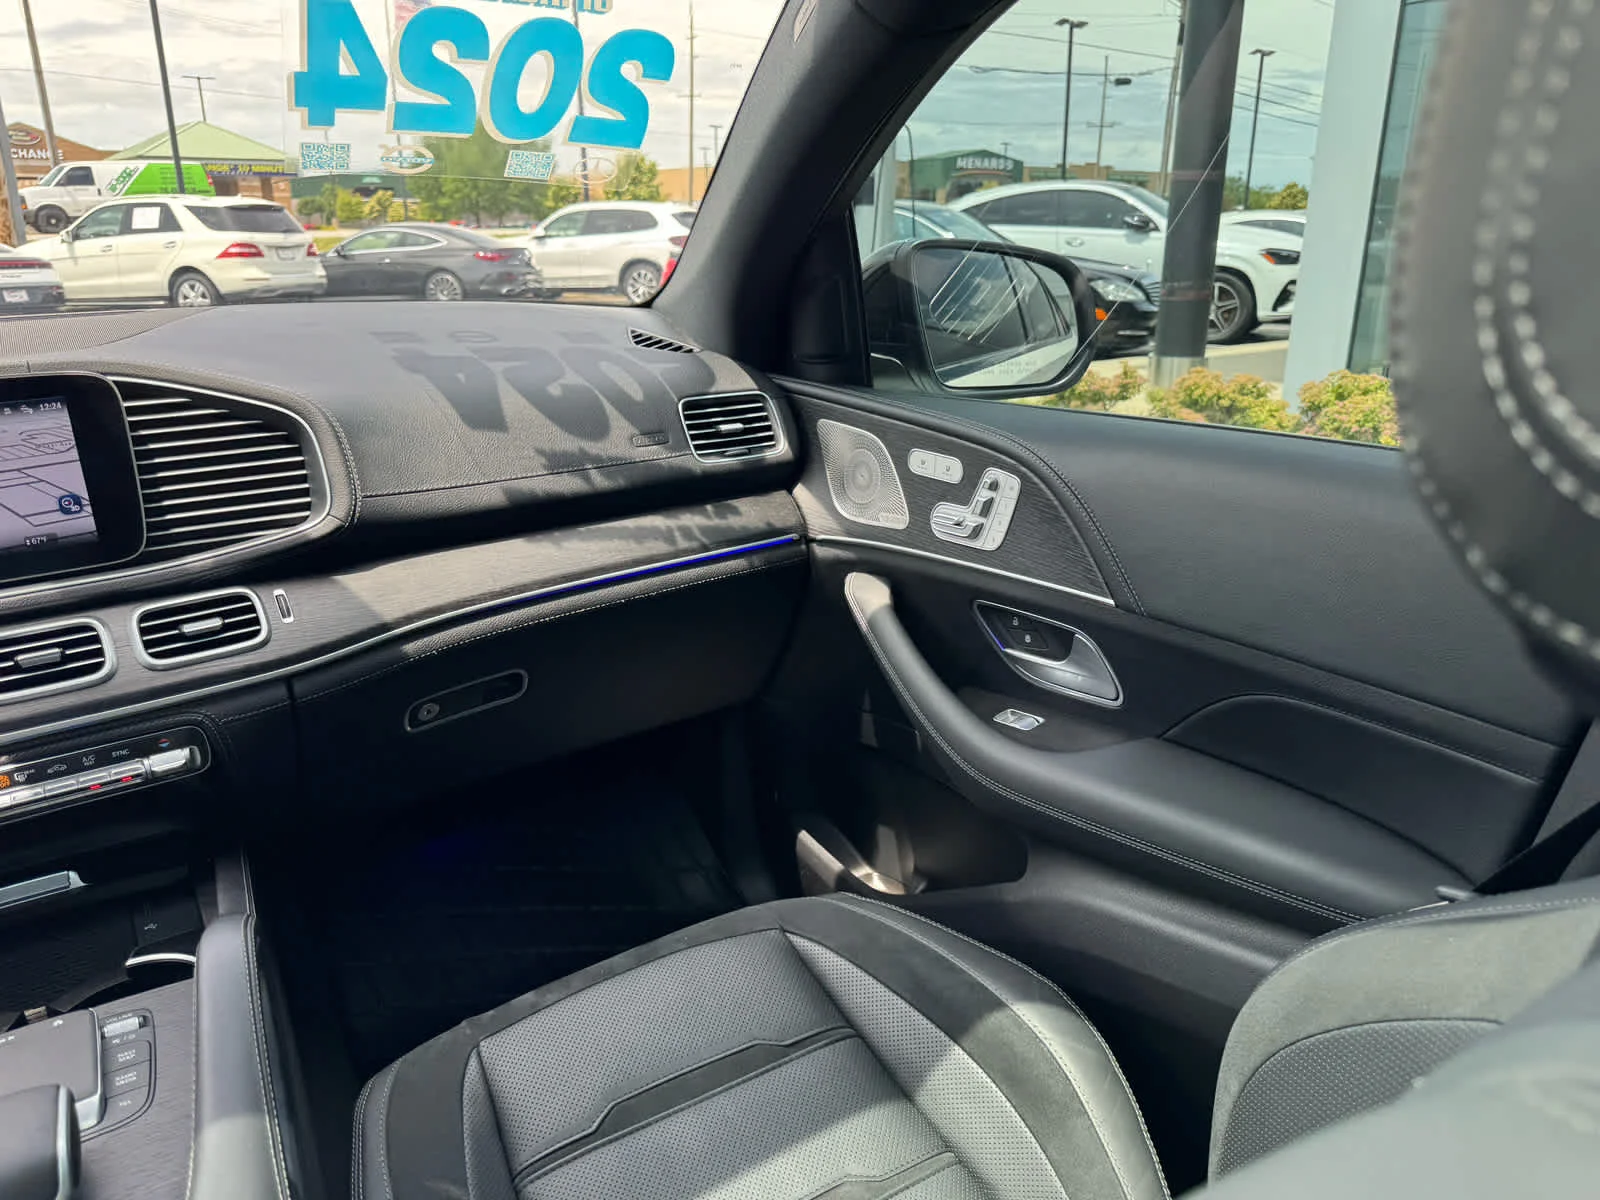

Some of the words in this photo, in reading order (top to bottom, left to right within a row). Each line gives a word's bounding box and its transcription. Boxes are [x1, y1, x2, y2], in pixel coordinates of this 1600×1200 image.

[10, 148, 64, 160] CHANE
[956, 156, 1014, 171] MENARDS
[39, 401, 62, 411] 12:24
